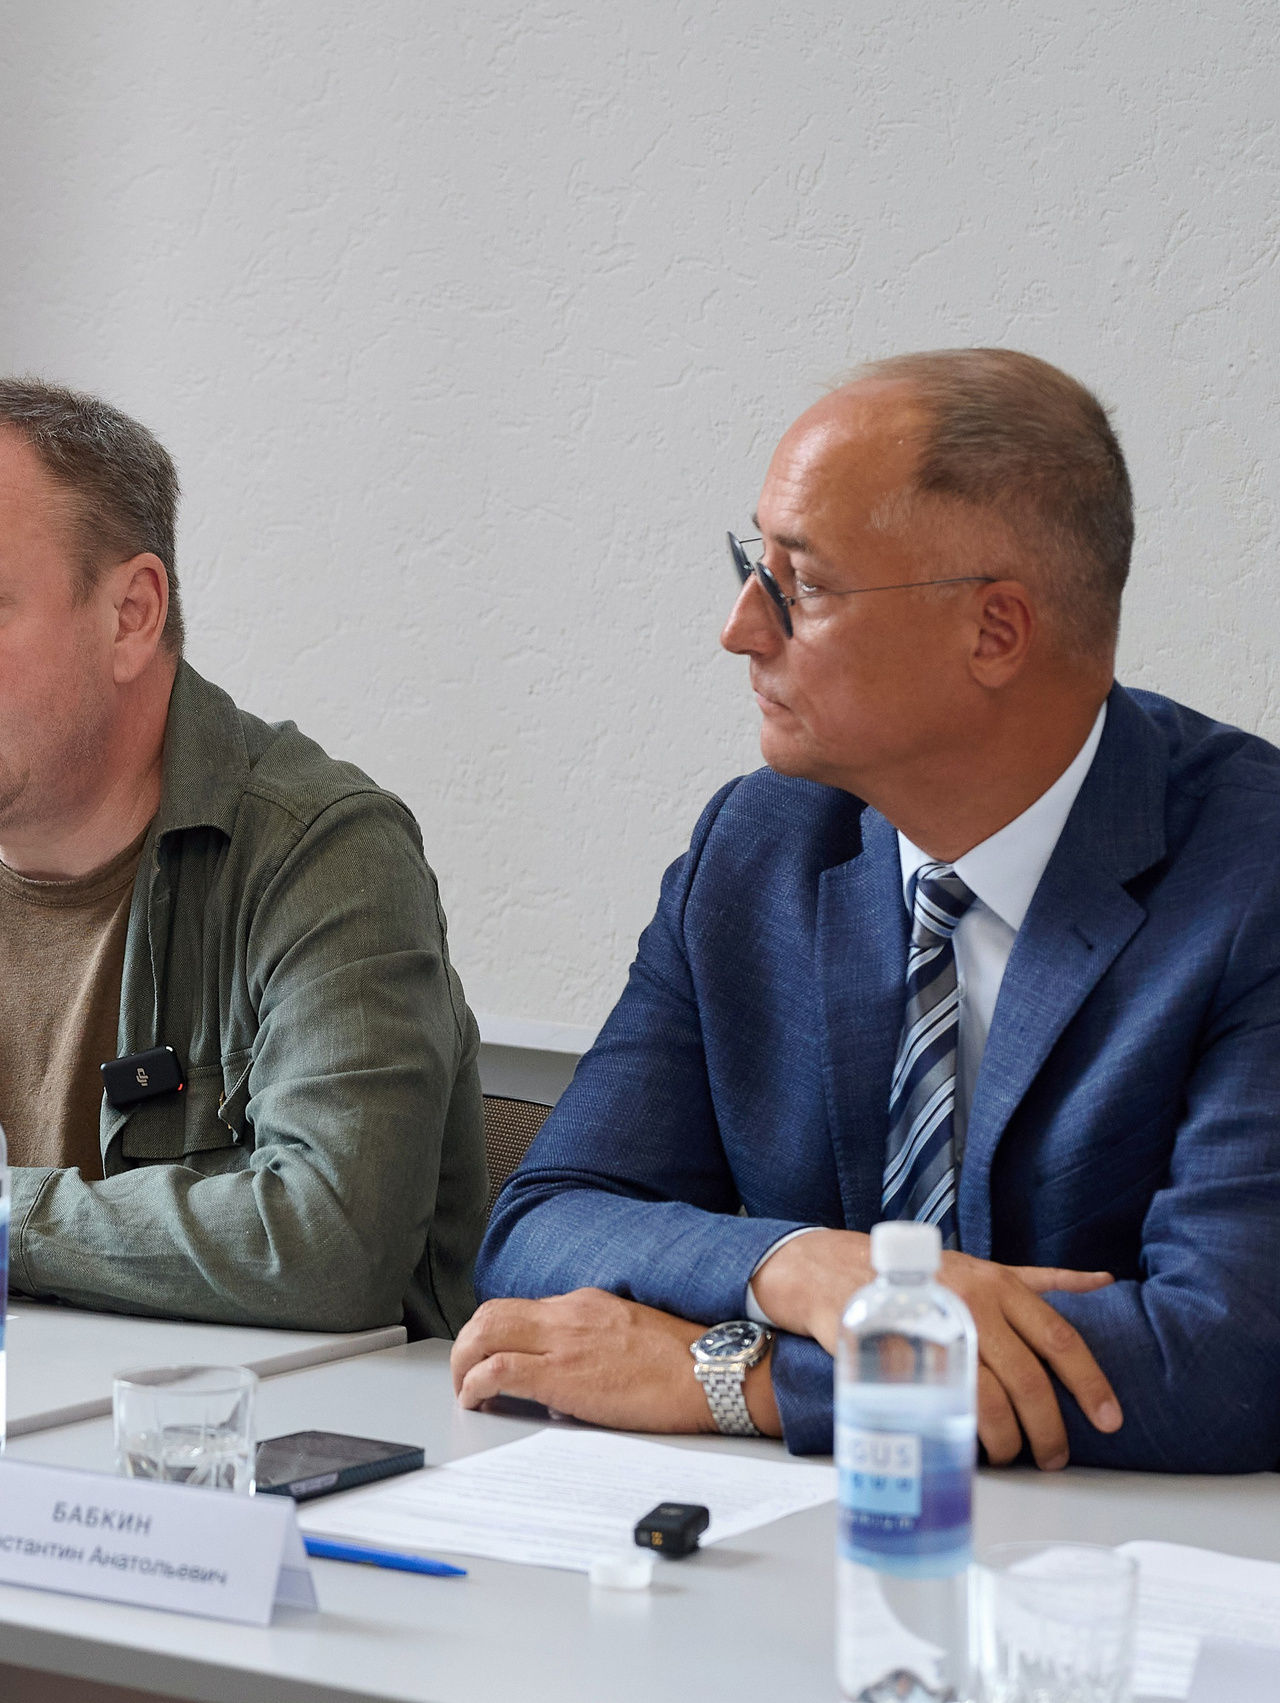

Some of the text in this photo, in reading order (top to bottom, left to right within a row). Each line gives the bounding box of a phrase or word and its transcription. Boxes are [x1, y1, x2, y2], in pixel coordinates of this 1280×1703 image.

[848, 1437, 914, 1469] GUS
[52, 1501, 152, 1536] БАБКИН
[88, 1549, 228, 1587] Анатольевич
